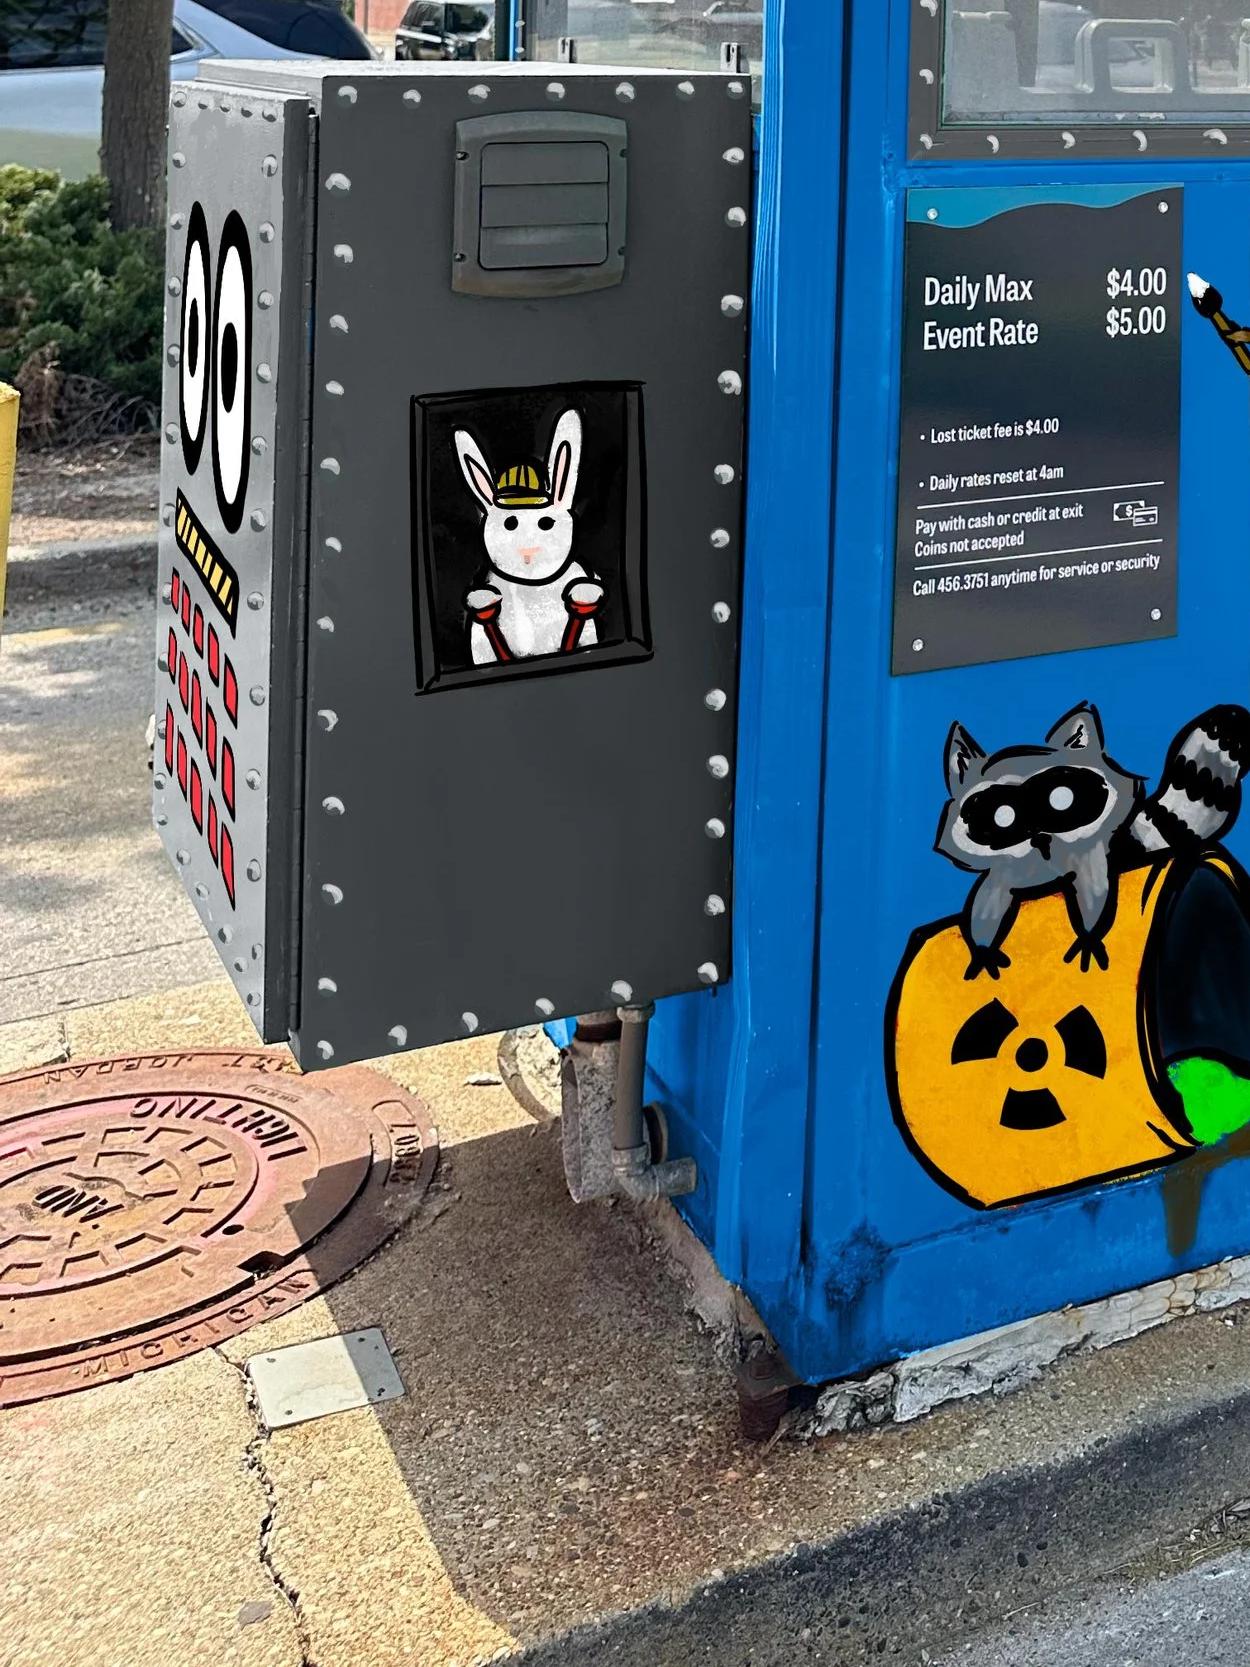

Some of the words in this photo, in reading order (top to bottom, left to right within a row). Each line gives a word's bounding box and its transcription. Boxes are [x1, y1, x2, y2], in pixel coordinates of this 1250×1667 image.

[924, 275, 980, 310] Daily
[985, 274, 1033, 303] Max
[1106, 267, 1167, 299] $4.00
[923, 321, 985, 350] Event
[989, 317, 1039, 346] Rate
[1105, 305, 1166, 338] $5.00
[931, 428, 956, 444] Lost
[958, 425, 992, 441] ticket
[994, 422, 1012, 438] fee
[1014, 421, 1024, 436] is
[1025, 417, 1060, 436] $4.00
[930, 473, 959, 493] Daily
[961, 473, 992, 488] rates
[993, 469, 1024, 484] reset
[1025, 467, 1038, 482] at
[1039, 465, 1064, 480] 4am
[915, 519, 937, 537] Pay
[939, 515, 966, 532] with
[967, 512, 995, 529] cash
[997, 513, 1010, 526] or
[1012, 506, 1047, 524] credit
[1048, 505, 1060, 521] at
[1062, 503, 1084, 519] exit
[914, 540, 948, 557] Coins
[949, 538, 970, 554] not
[971, 530, 1025, 551] accepted
[912, 578, 936, 596] Call
[937, 572, 989, 593] 456.3751
[990, 568, 1037, 588] anytime
[1039, 565, 1056, 581] for
[1058, 561, 1099, 579] service
[1101, 560, 1115, 573] or
[1115, 553, 1160, 570] security
[130, 1097, 308, 1162] LIGHTING
[80, 1278, 311, 1379] MICHIGAN
